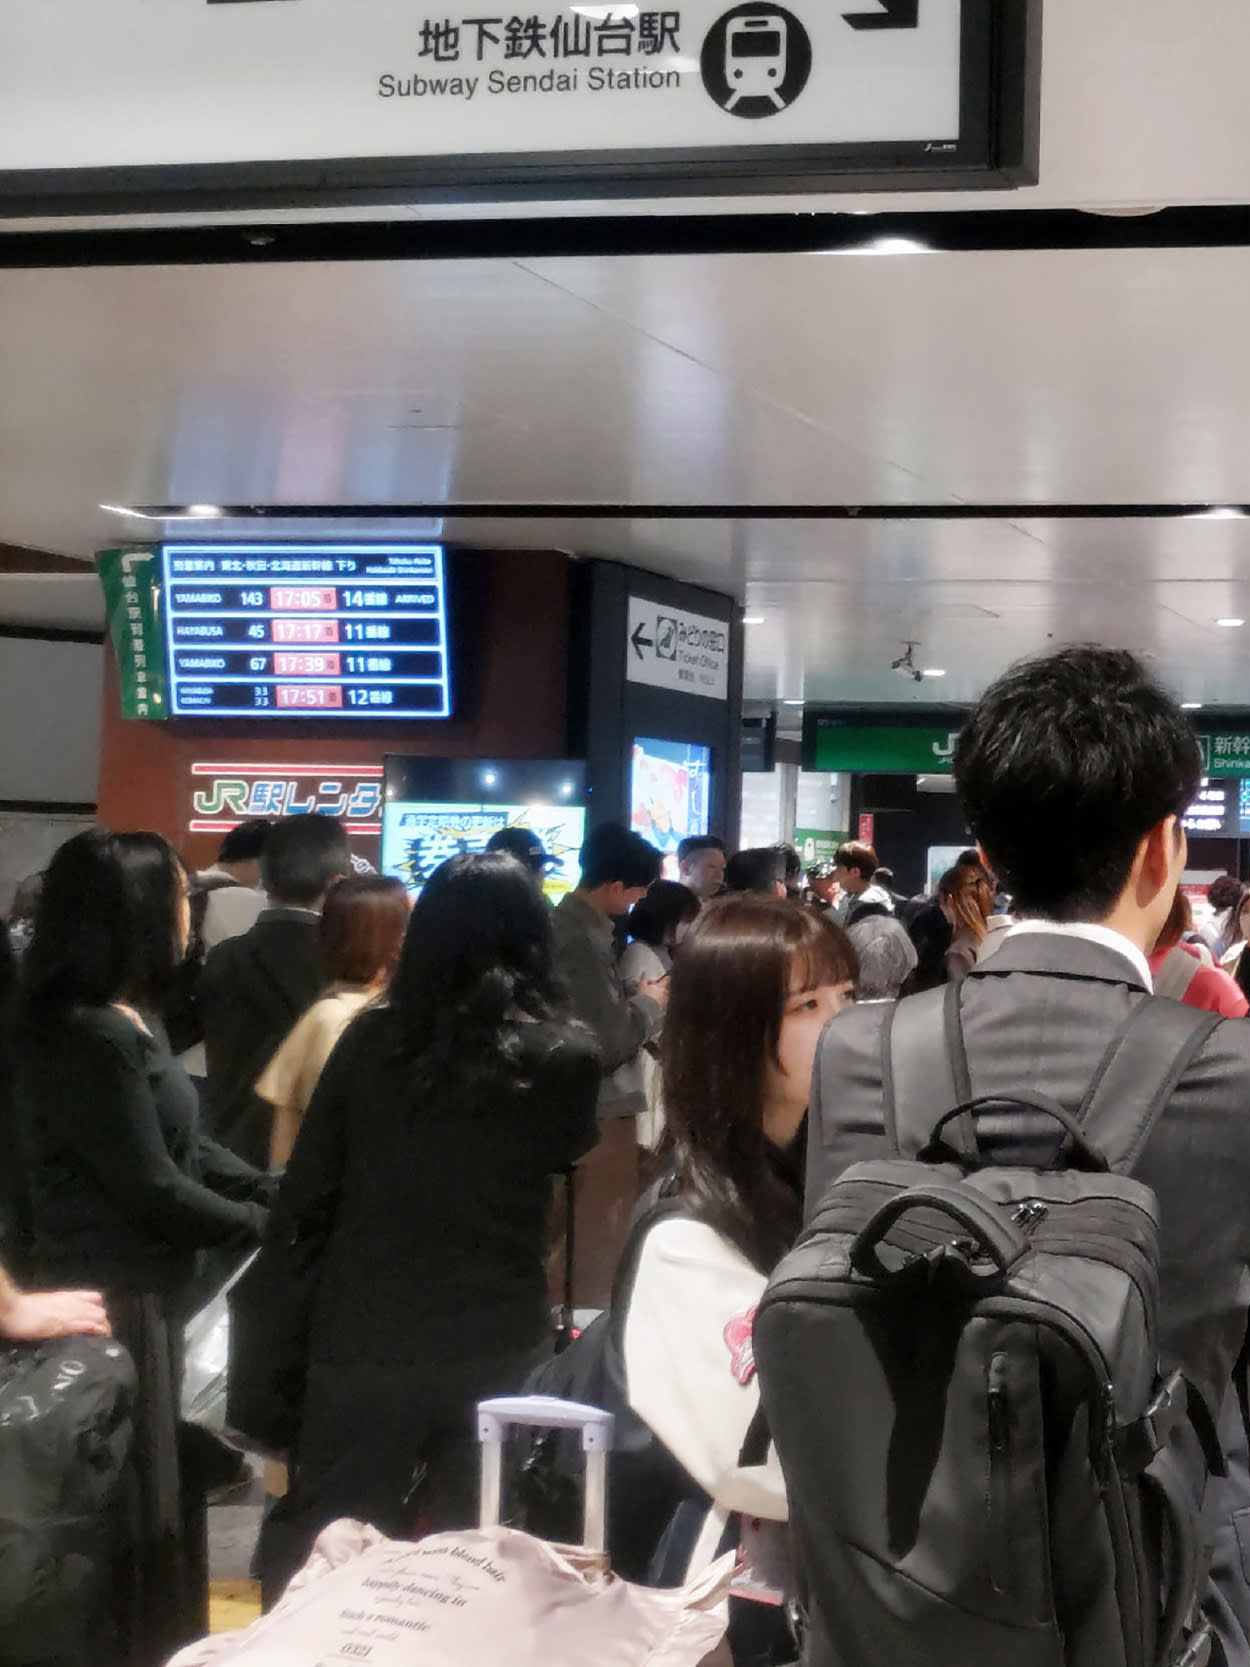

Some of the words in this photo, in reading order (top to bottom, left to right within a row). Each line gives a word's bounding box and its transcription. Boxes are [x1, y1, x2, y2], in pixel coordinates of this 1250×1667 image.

[417, 11, 681, 62] 地下鉄仙台駅
[378, 74, 479, 100] Subway
[488, 67, 578, 94] Sendai
[588, 66, 680, 91] Station
[241, 591, 265, 606] 143
[276, 590, 321, 607] 17:05
[177, 625, 224, 637] HAYABUSA
[248, 624, 265, 638] 45
[278, 622, 323, 640] 17:17
[249, 657, 267, 671] 67
[279, 656, 326, 673] 17:39
[281, 688, 326, 706] 17:51
[193, 779, 383, 818] JR駅レンタ
[482, 1557, 507, 1583] hair
[402, 1582, 450, 1605] dancing
[451, 1594, 468, 1608] in
